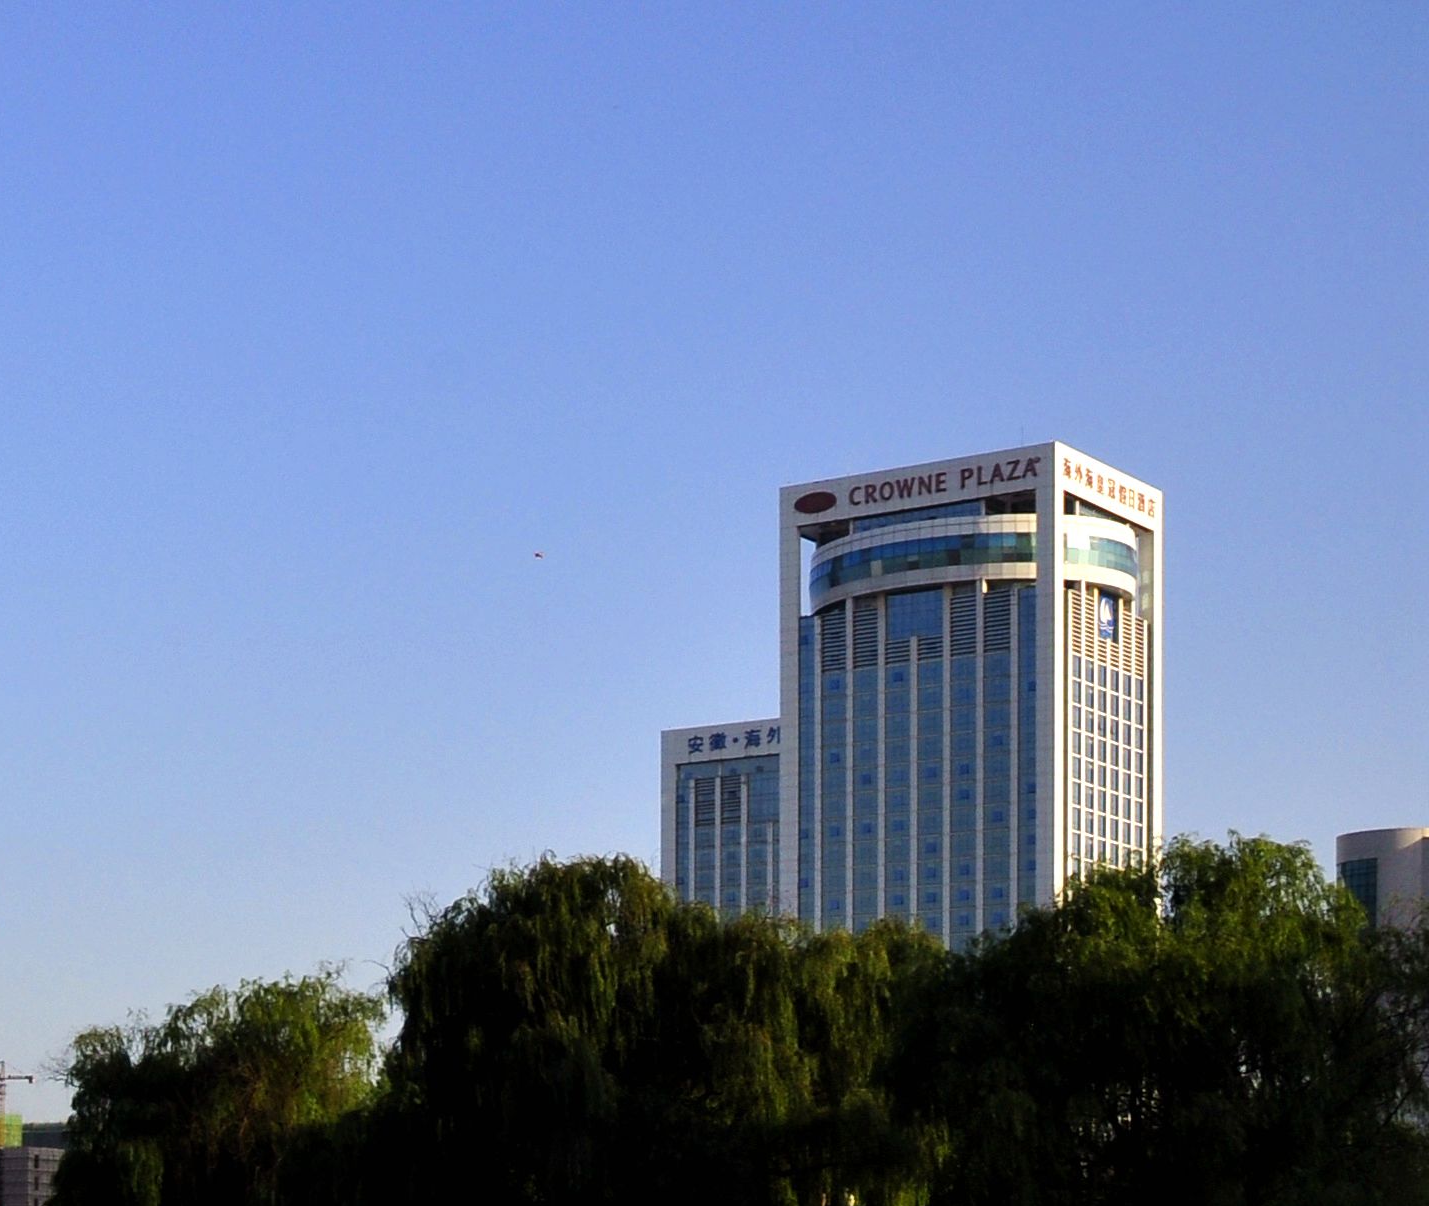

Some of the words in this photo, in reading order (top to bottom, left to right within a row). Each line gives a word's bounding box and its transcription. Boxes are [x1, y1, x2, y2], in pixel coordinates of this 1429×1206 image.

[848, 471, 947, 506] CROWNE
[959, 457, 1039, 489] PLAZA
[1063, 457, 1156, 518] 海外海皇冠假日酒店
